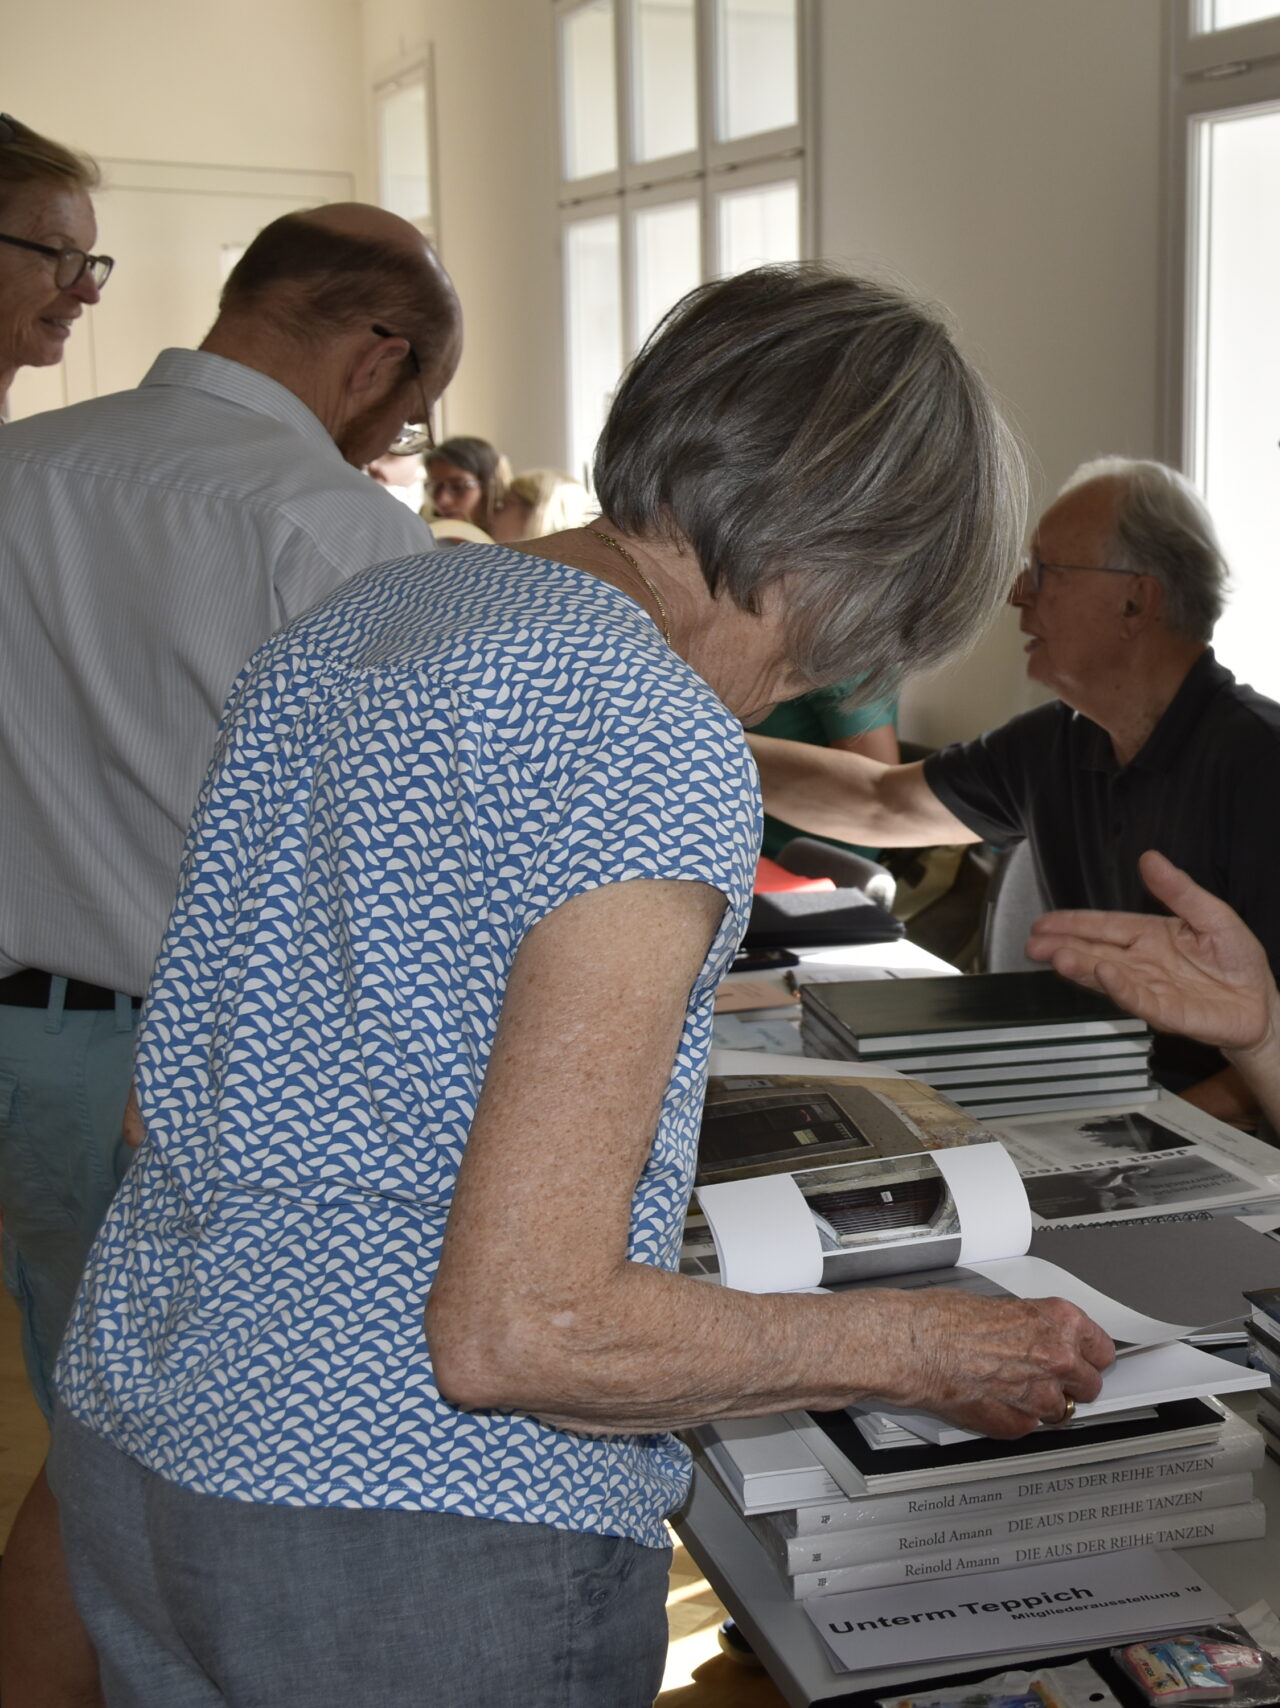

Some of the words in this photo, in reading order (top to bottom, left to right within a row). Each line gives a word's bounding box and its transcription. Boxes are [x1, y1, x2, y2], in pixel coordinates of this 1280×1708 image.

[1070, 1158, 1121, 1172] erst
[1127, 1148, 1189, 1164] Jetzt
[908, 1495, 956, 1513] Reinold
[958, 1489, 1003, 1507] Amann
[1018, 1481, 1044, 1497] DIE
[1046, 1478, 1075, 1493] AUS
[1077, 1473, 1108, 1488] DER
[1111, 1466, 1155, 1484] REIHE
[1155, 1457, 1215, 1477] TANZEN
[898, 1533, 946, 1550] Reinold
[948, 1526, 993, 1543] Amann
[1008, 1518, 1034, 1534] DIE
[1036, 1513, 1065, 1529] AUS
[1067, 1508, 1098, 1524] DER
[1100, 1501, 1144, 1519] REIHE
[1145, 1491, 1204, 1511] TANZEN
[904, 1560, 952, 1577] Reinold
[955, 1554, 1000, 1571] Amann
[1015, 1548, 1041, 1563] DIE
[1043, 1543, 1072, 1559] AUS
[1075, 1538, 1107, 1554] DER
[1110, 1532, 1154, 1549] REIHE
[1155, 1523, 1215, 1544] TANZEN
[828, 1606, 957, 1635] Unterm
[958, 1586, 1095, 1617] Teppich
[1010, 1591, 1181, 1621] Mitgliederausstellung
